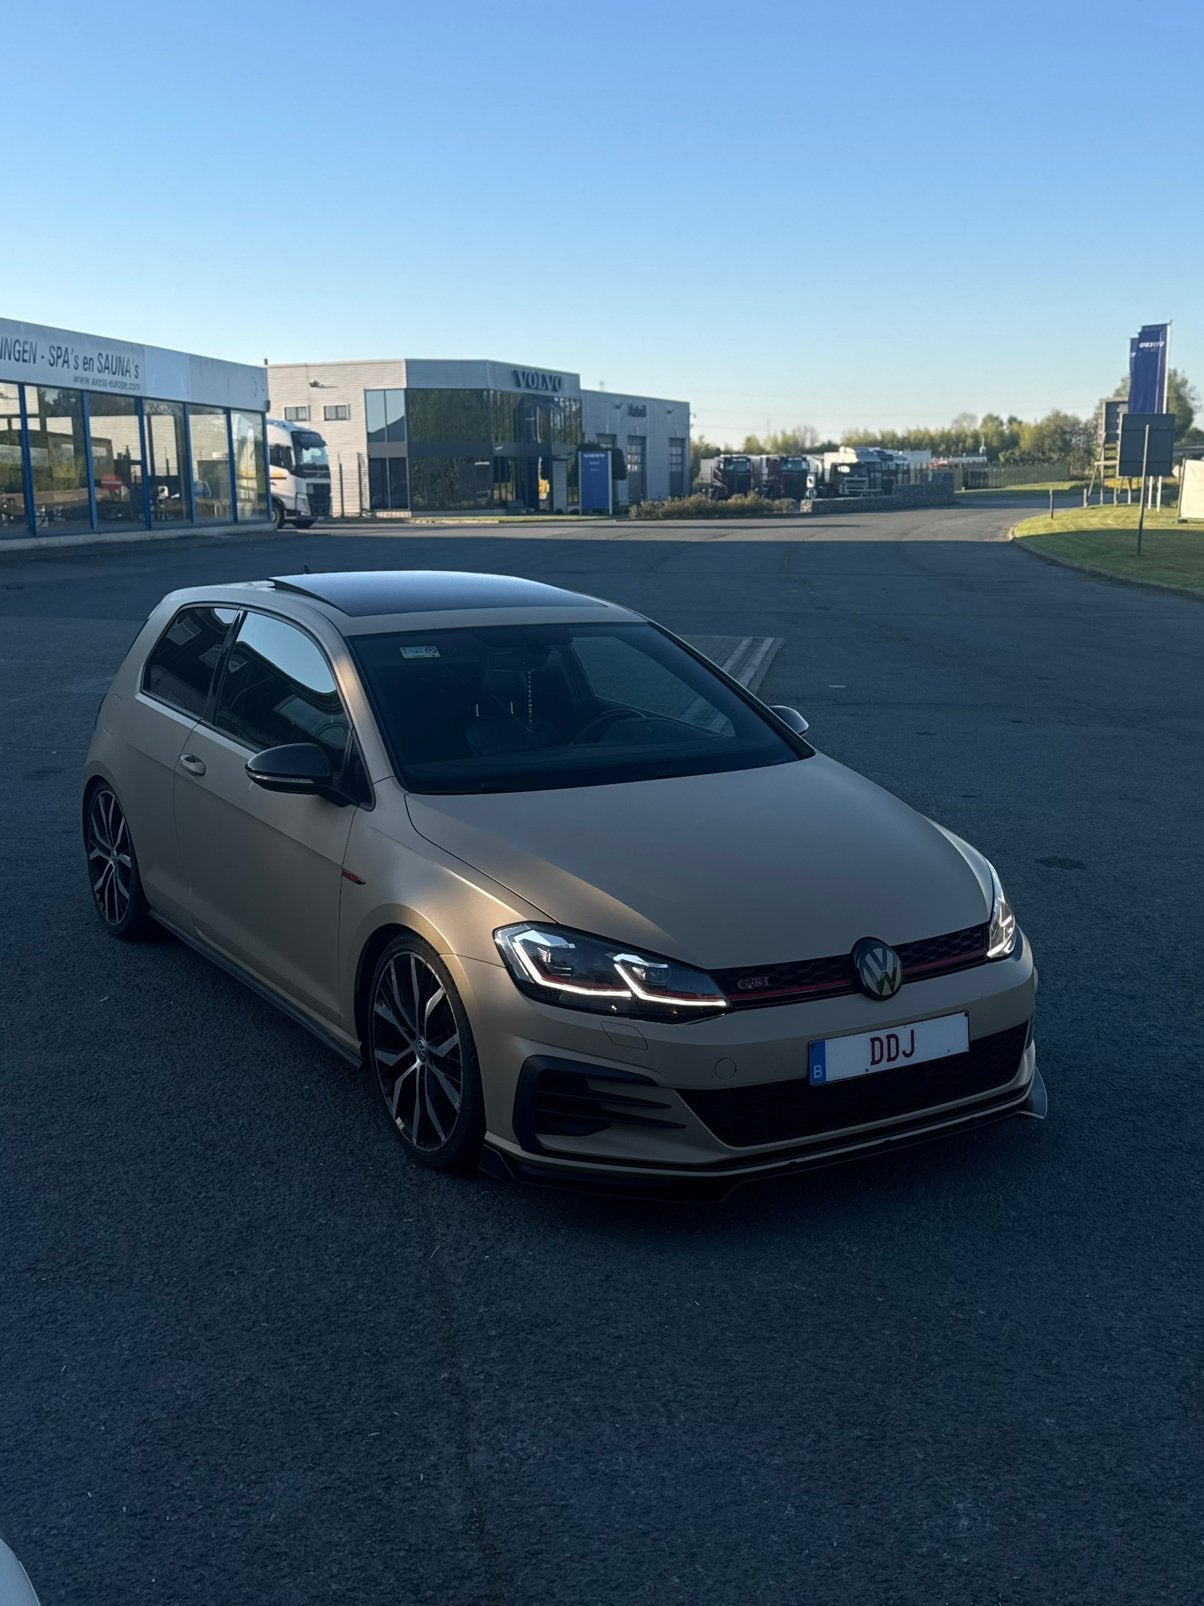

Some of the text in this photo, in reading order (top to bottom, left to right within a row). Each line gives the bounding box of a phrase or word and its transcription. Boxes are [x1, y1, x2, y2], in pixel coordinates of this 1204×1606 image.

[0, 337, 38, 364] INGEN
[48, 344, 79, 370] SPA's
[82, 355, 95, 372] en
[97, 352, 140, 379] SAUNA's
[511, 369, 562, 392] VOLVO
[869, 1028, 916, 1066] DDJ
[813, 1065, 824, 1079] B
